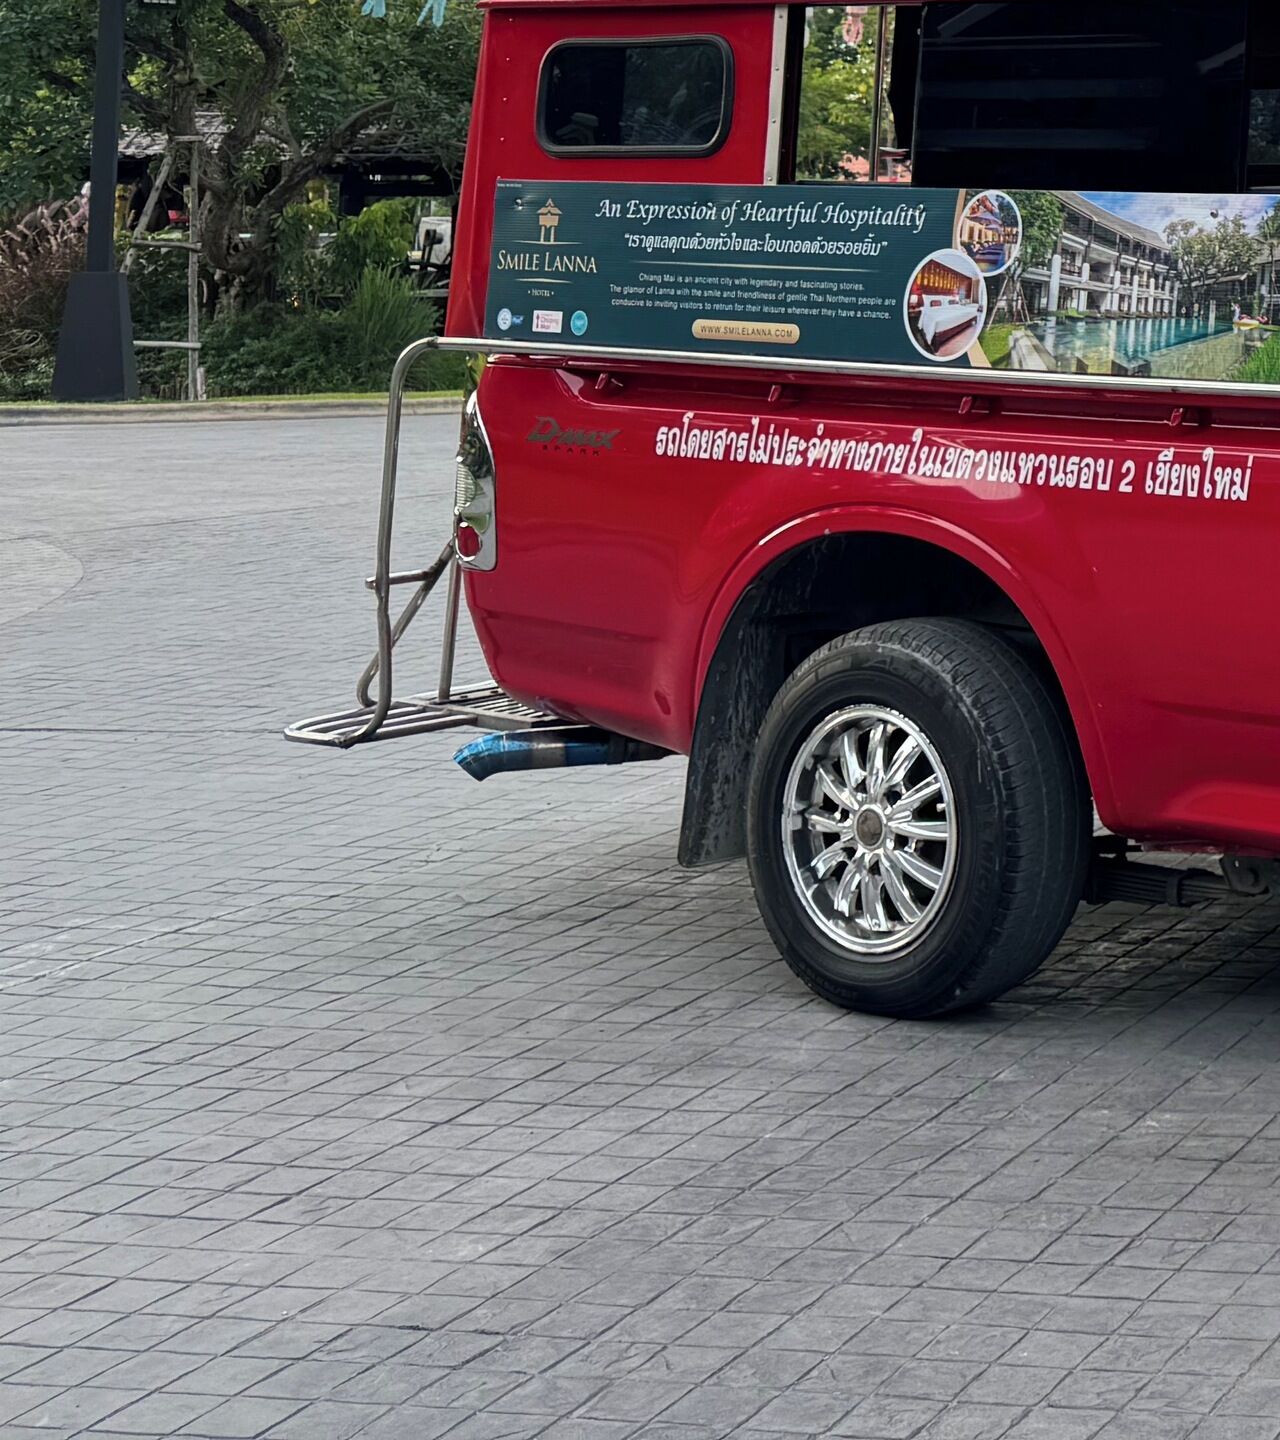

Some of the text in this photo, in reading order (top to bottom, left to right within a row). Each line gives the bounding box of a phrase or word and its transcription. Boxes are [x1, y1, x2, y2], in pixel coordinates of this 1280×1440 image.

[595, 199, 926, 234] An Expression of Heartful Hospitality
[497, 250, 598, 274] SMILE LANNA
[639, 273, 662, 283] Chiang
[664, 274, 675, 282] Mai
[694, 276, 719, 284] ancient
[720, 277, 732, 286] city
[749, 278, 783, 288] legendary
[785, 280, 798, 288] and
[800, 280, 837, 291] fascinating
[610, 284, 621, 292] The
[623, 285, 645, 295] glamor
[646, 286, 654, 294] of
[655, 286, 675, 295] Lanna
[676, 288, 690, 296] with
[691, 288, 702, 297] the
[703, 289, 721, 298] smile
[723, 289, 735, 298] and
[777, 292, 785, 300] of
[786, 292, 808, 302] gentle
[809, 293, 825, 302] Thai
[826, 294, 856, 303] Northern
[858, 296, 883, 306] people
[884, 298, 896, 306] are
[611, 299, 644, 307] conducive
[646, 299, 652, 307] to
[679, 301, 703, 310] visitors
[704, 302, 711, 310] to
[734, 303, 744, 311] for
[745, 304, 761, 312] their
[762, 304, 785, 314] leisure
[787, 306, 820, 315] whenever
[821, 308, 836, 318] they
[838, 309, 854, 317] have
[700, 325, 793, 337] WWW.SMILELANNA.COM
[656, 411, 1252, 501] รถโดยสารไม่ประจำทางภายในเขตวงแหวนรอบ 2 เชียงใหม่
